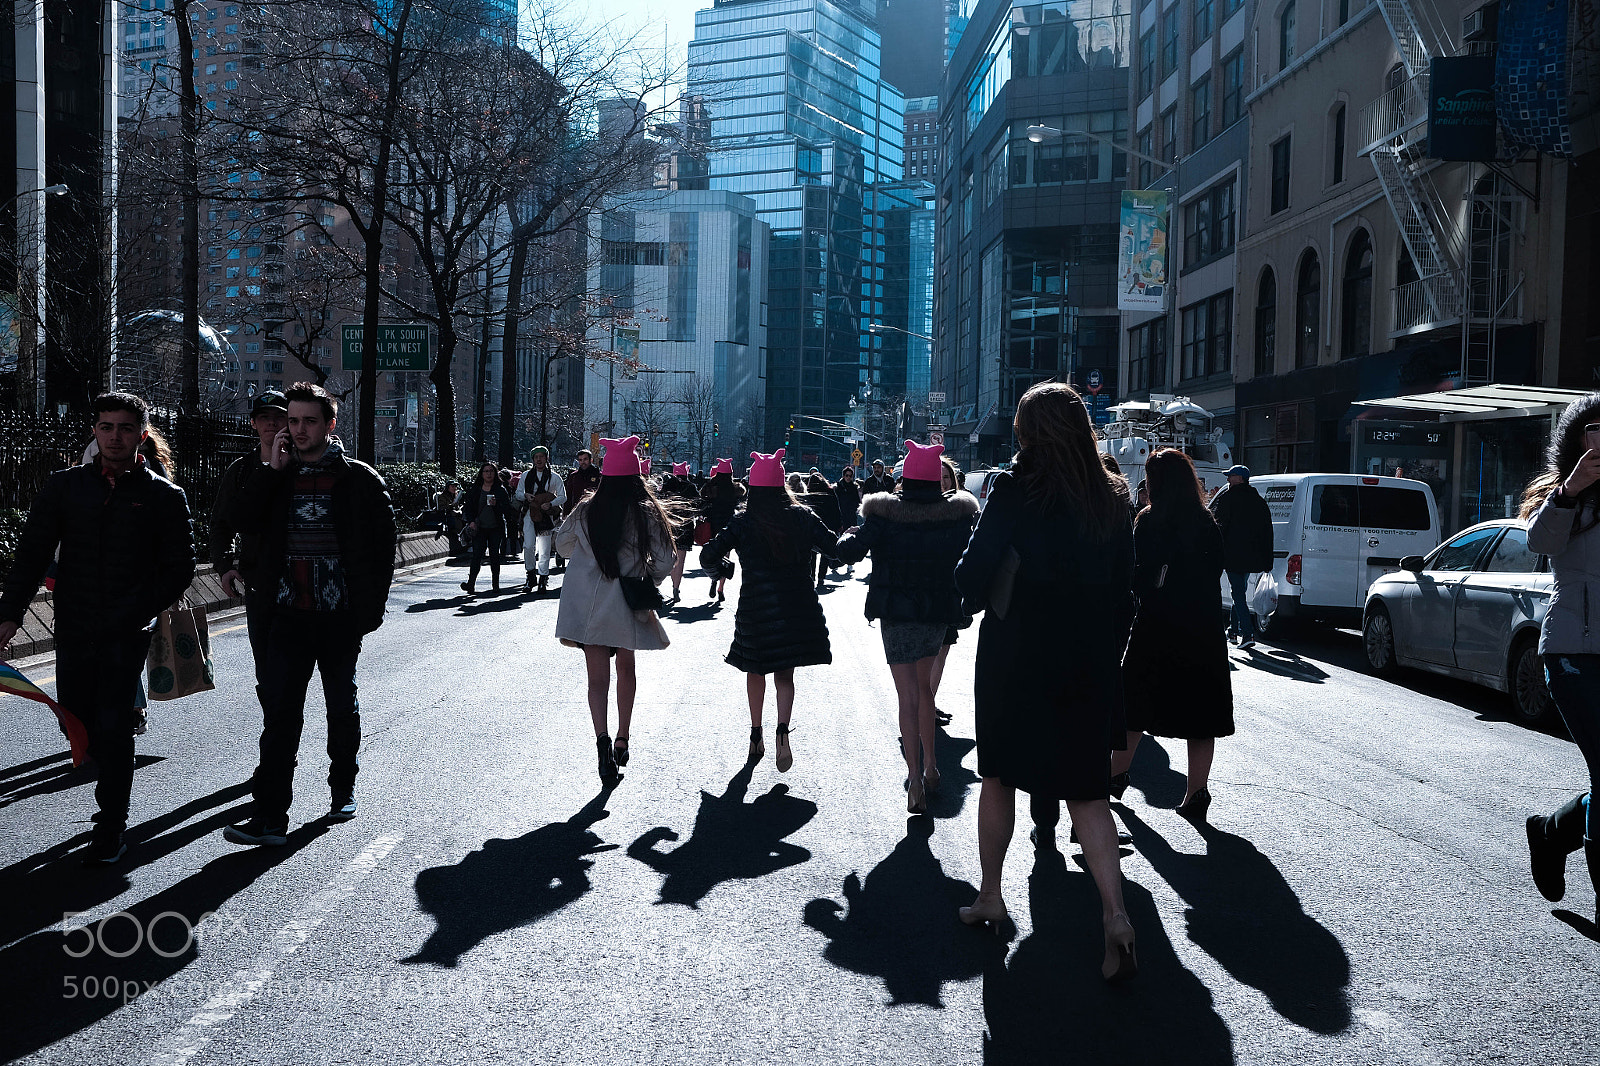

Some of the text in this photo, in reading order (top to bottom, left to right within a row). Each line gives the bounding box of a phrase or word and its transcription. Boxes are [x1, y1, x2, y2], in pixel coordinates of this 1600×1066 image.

[344, 329, 426, 340] CENTL PK SOUTH
[349, 342, 422, 353] CENAL PK WEST
[386, 358, 410, 367] LANE
[1265, 489, 1295, 501] enterprise
[1304, 524, 1360, 534] enterprise.com
[1381, 529, 1418, 537] rent-a-car
